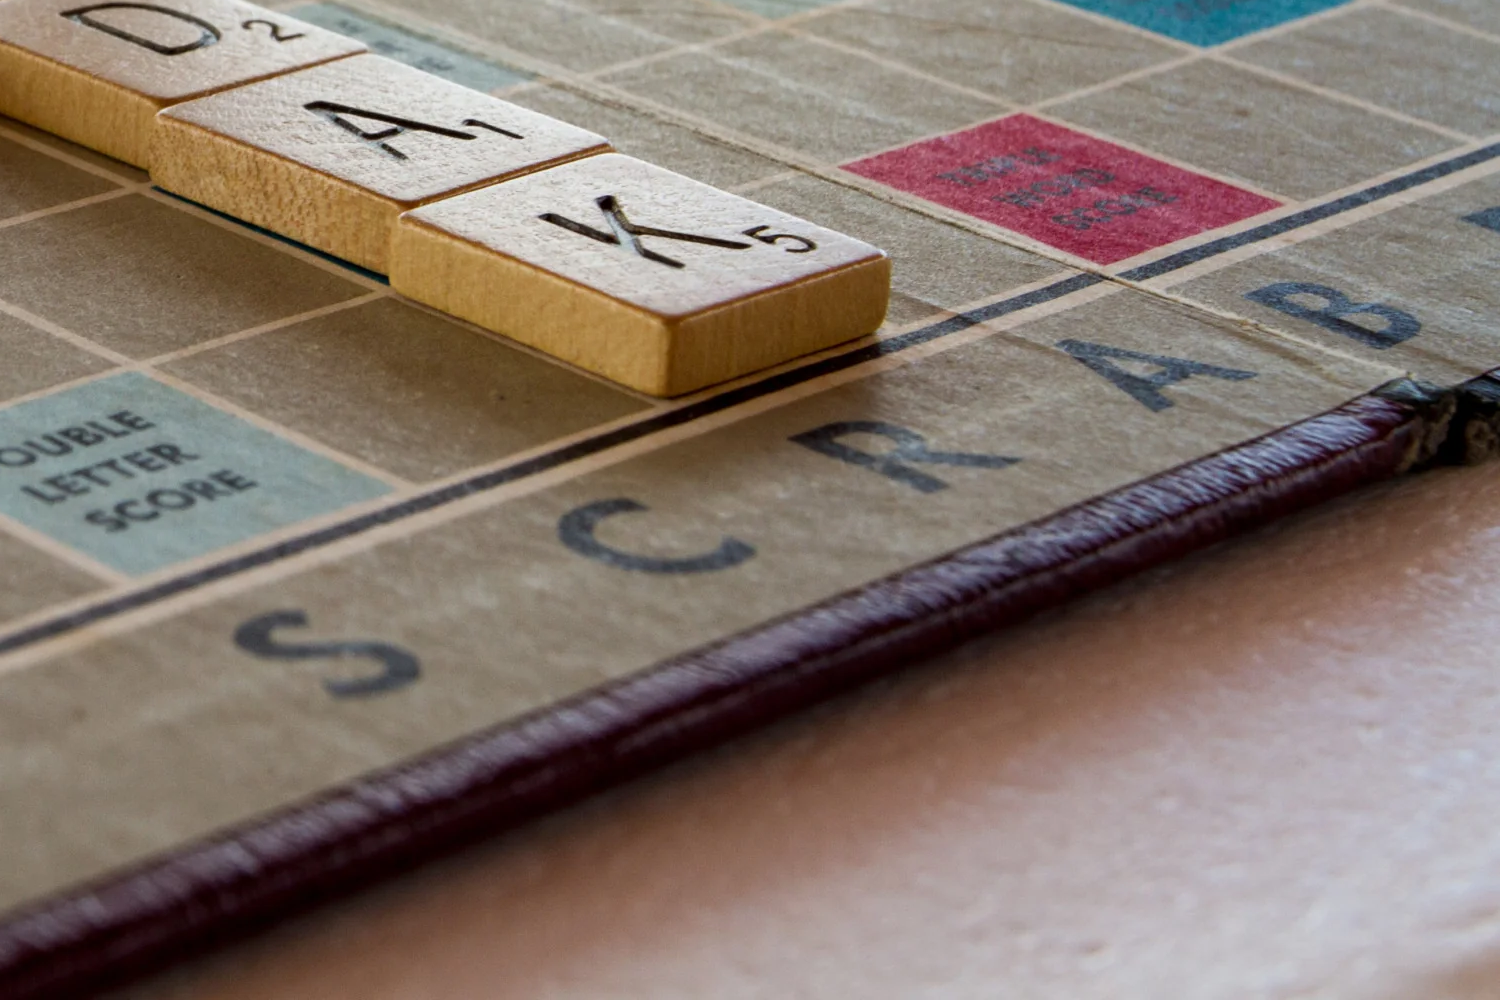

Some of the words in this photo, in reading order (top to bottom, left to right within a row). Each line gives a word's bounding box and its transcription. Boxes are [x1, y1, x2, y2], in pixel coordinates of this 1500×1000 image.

[60, 1, 222, 57] D
[241, 18, 307, 43] 2
[303, 99, 476, 161] A
[537, 194, 751, 270] K
[742, 223, 819, 255] 5
[19, 443, 200, 506] LETTER
[83, 468, 259, 533] SCORE
